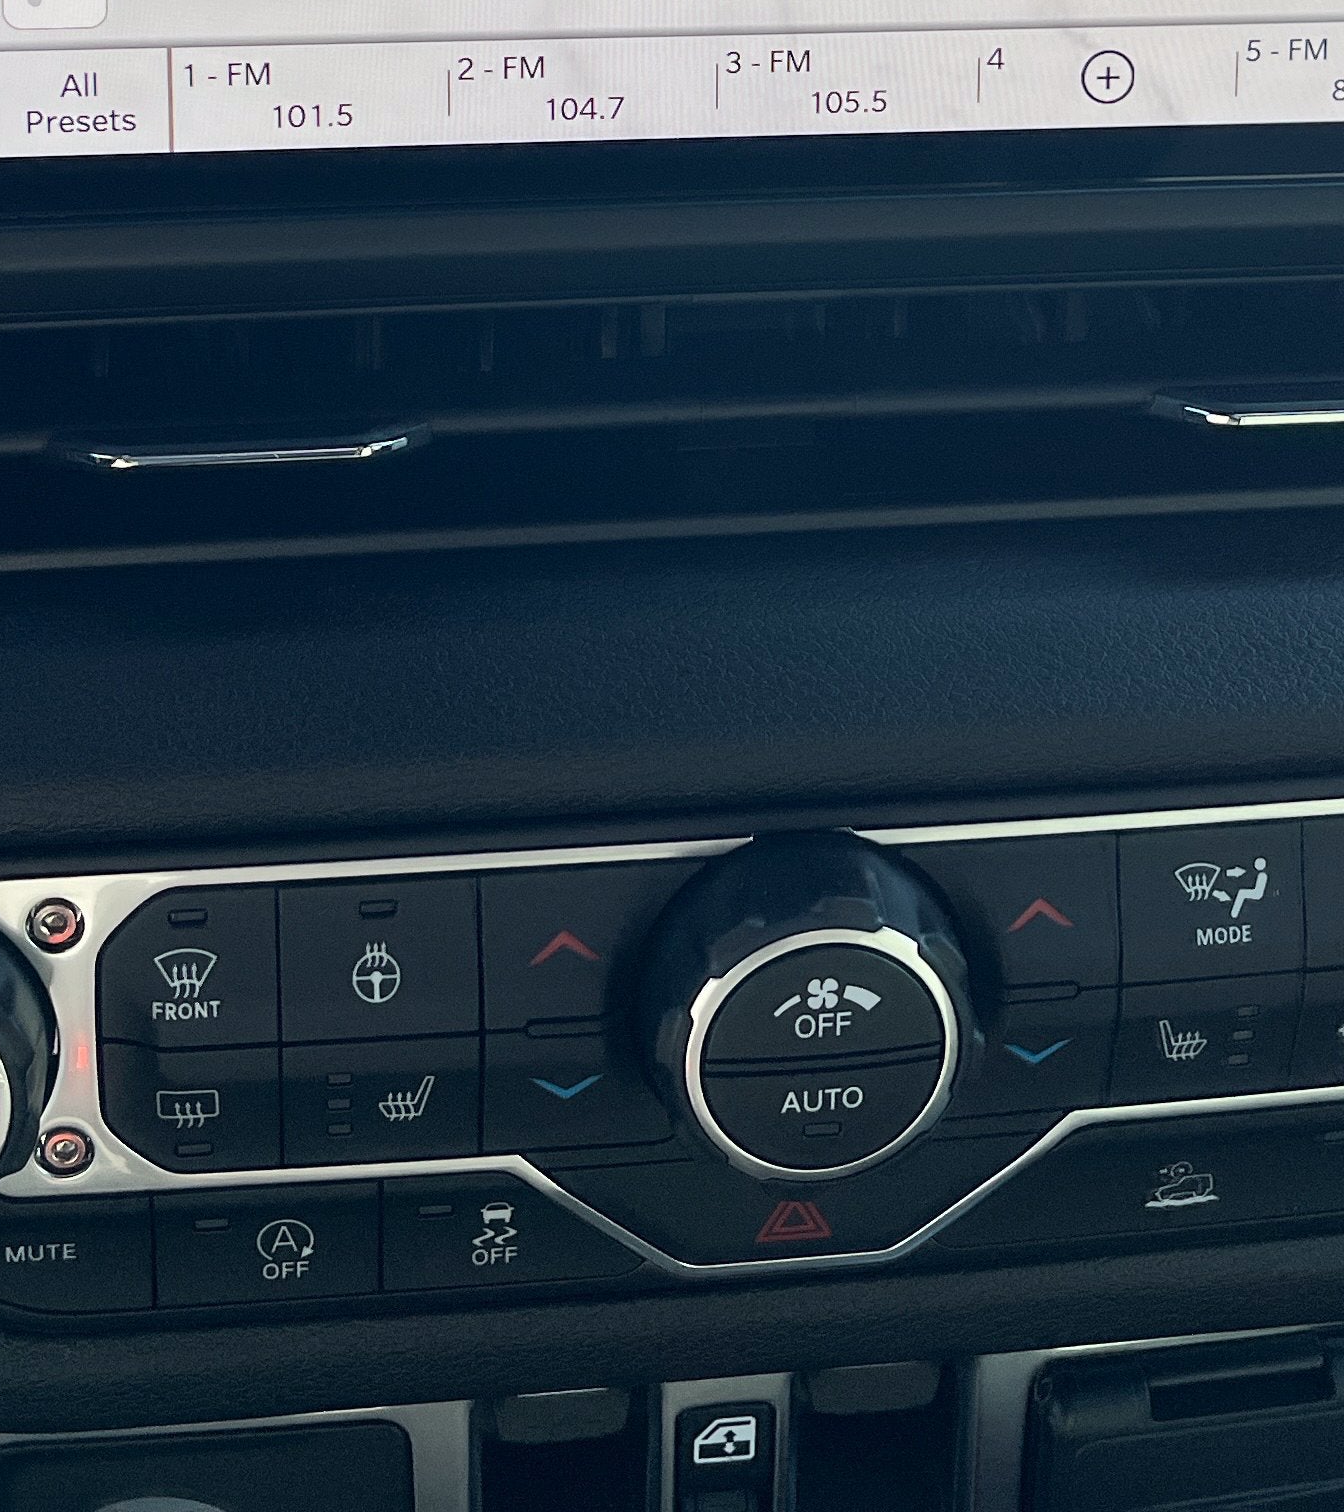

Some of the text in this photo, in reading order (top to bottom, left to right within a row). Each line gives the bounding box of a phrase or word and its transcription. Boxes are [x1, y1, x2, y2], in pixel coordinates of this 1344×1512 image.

[725, 52, 742, 74] 3
[769, 50, 811, 73] FM
[987, 47, 1005, 70] 4
[1246, 39, 1262, 63] 5
[1288, 38, 1328, 61] FM
[184, 64, 195, 87] 1
[227, 62, 272, 86] FM
[457, 58, 474, 81] 2
[502, 56, 545, 80] FM
[60, 72, 99, 98] All
[545, 96, 625, 122] 104.7
[810, 90, 888, 115] 105.5
[26, 109, 137, 134] Presets
[272, 103, 354, 129] 101.5
[1196, 924, 1253, 946] MODE
[152, 1000, 221, 1020] FRONT
[794, 1010, 852, 1040] OFF
[780, 1086, 864, 1114] AUTO
[5, 1242, 77, 1263] MUTE
[471, 1246, 518, 1266] OFF
[262, 1259, 310, 1280] OFF
